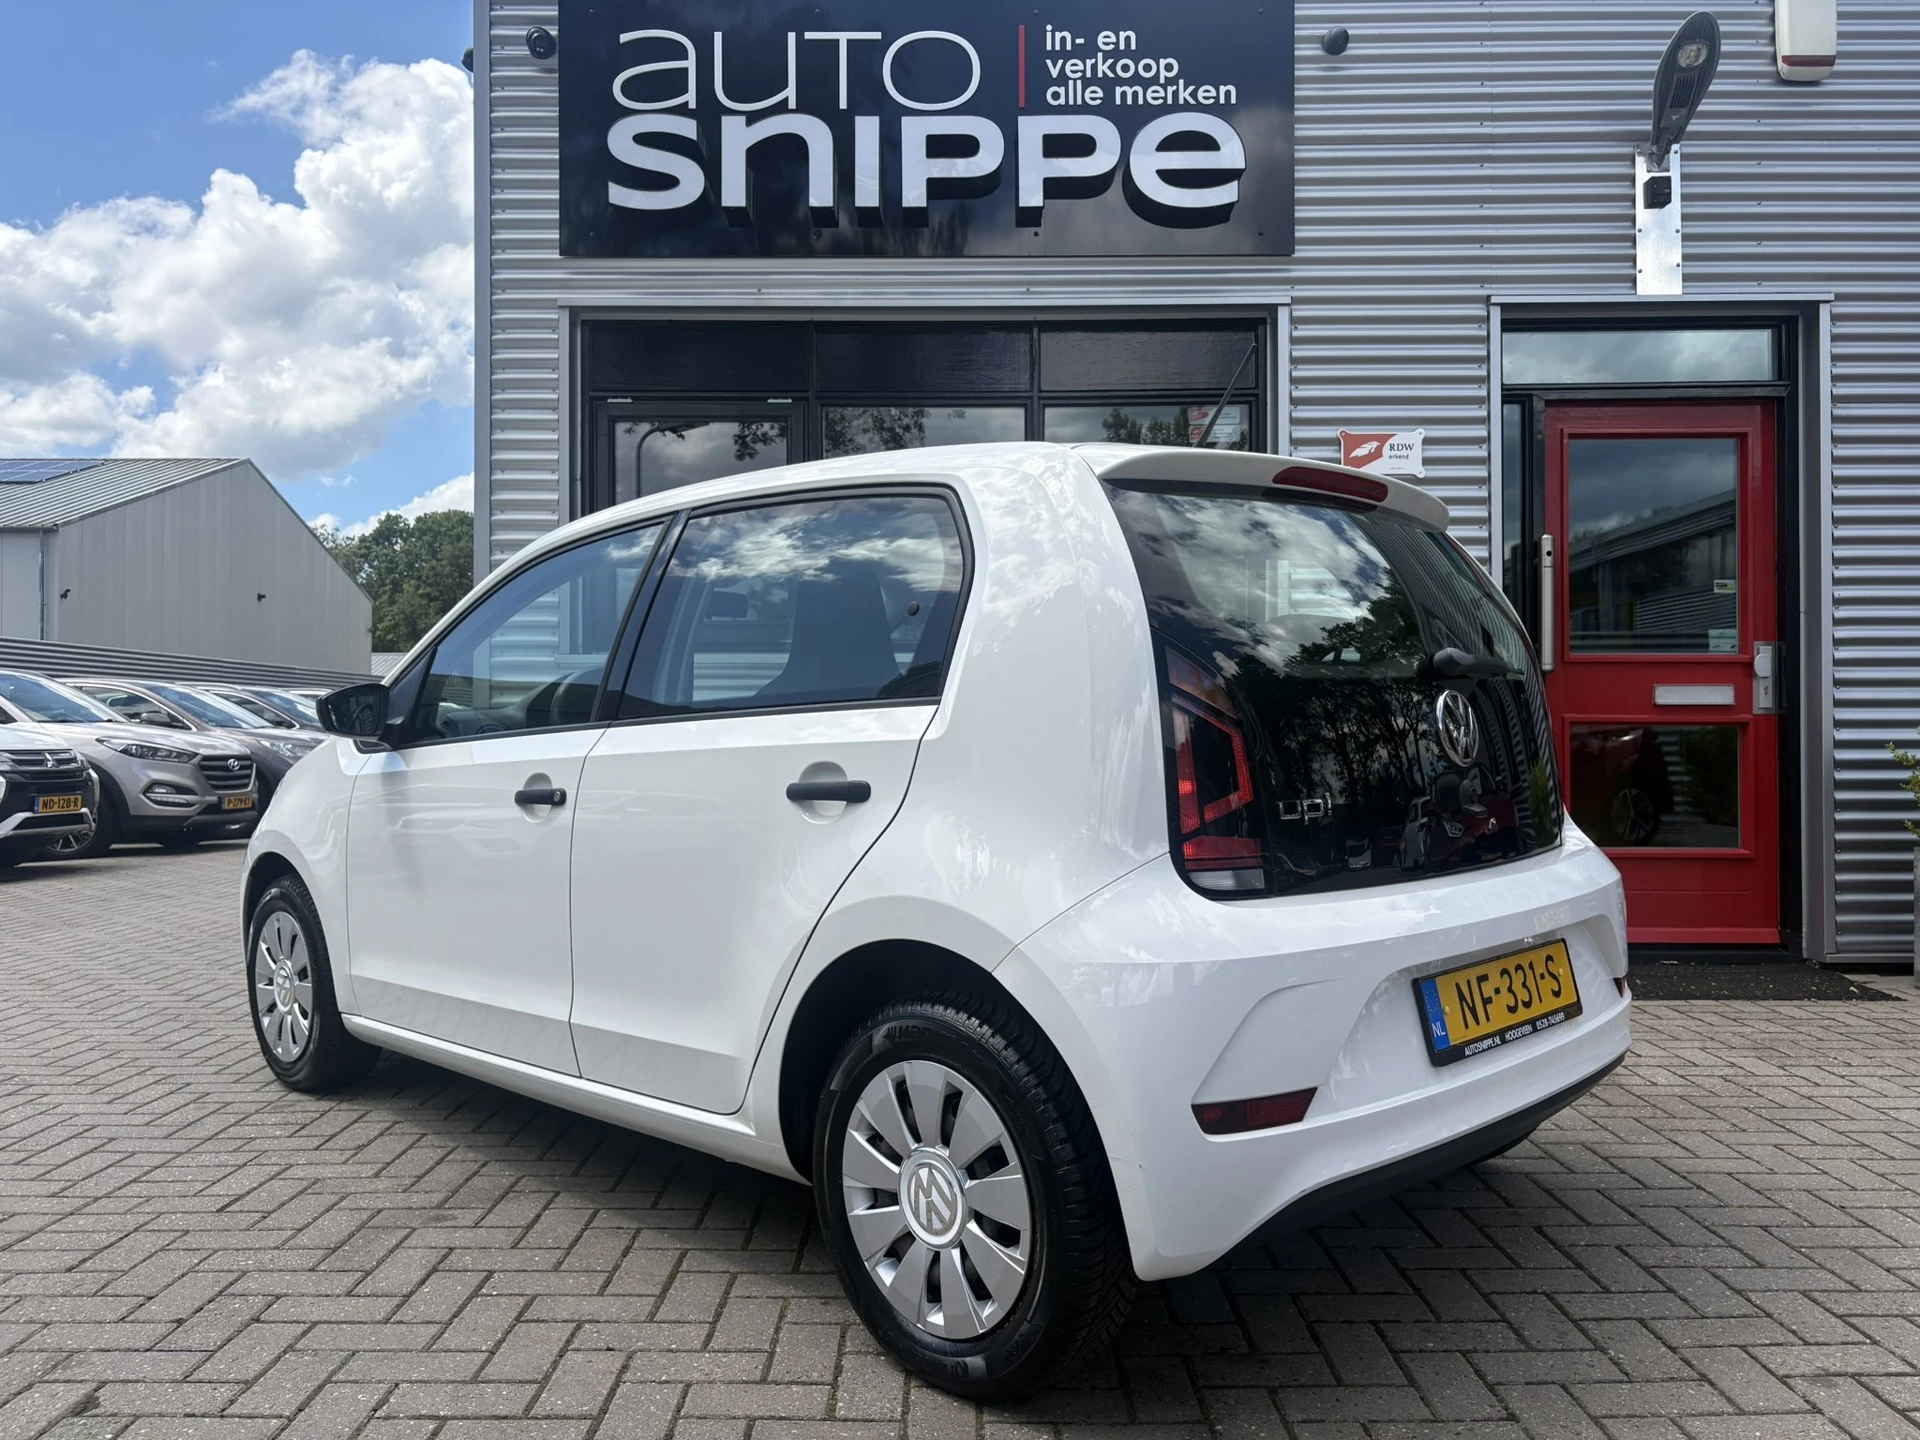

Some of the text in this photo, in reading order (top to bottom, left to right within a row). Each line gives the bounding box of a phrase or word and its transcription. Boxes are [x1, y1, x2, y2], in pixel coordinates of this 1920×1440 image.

[1045, 24, 1137, 51] in- en
[1045, 54, 1180, 83] verkoop
[1045, 80, 1237, 106] alle merken
[1389, 443, 1415, 452] RDW
[42, 797, 79, 810] ND-128-R
[1276, 792, 1332, 825] up!
[1455, 954, 1562, 1030] NF-331-S
[1432, 1021, 1446, 1038] NL
[1464, 1035, 1501, 1056] AUTOSNIPPE.NL
[1505, 1024, 1533, 1041] HOOGEVEEN
